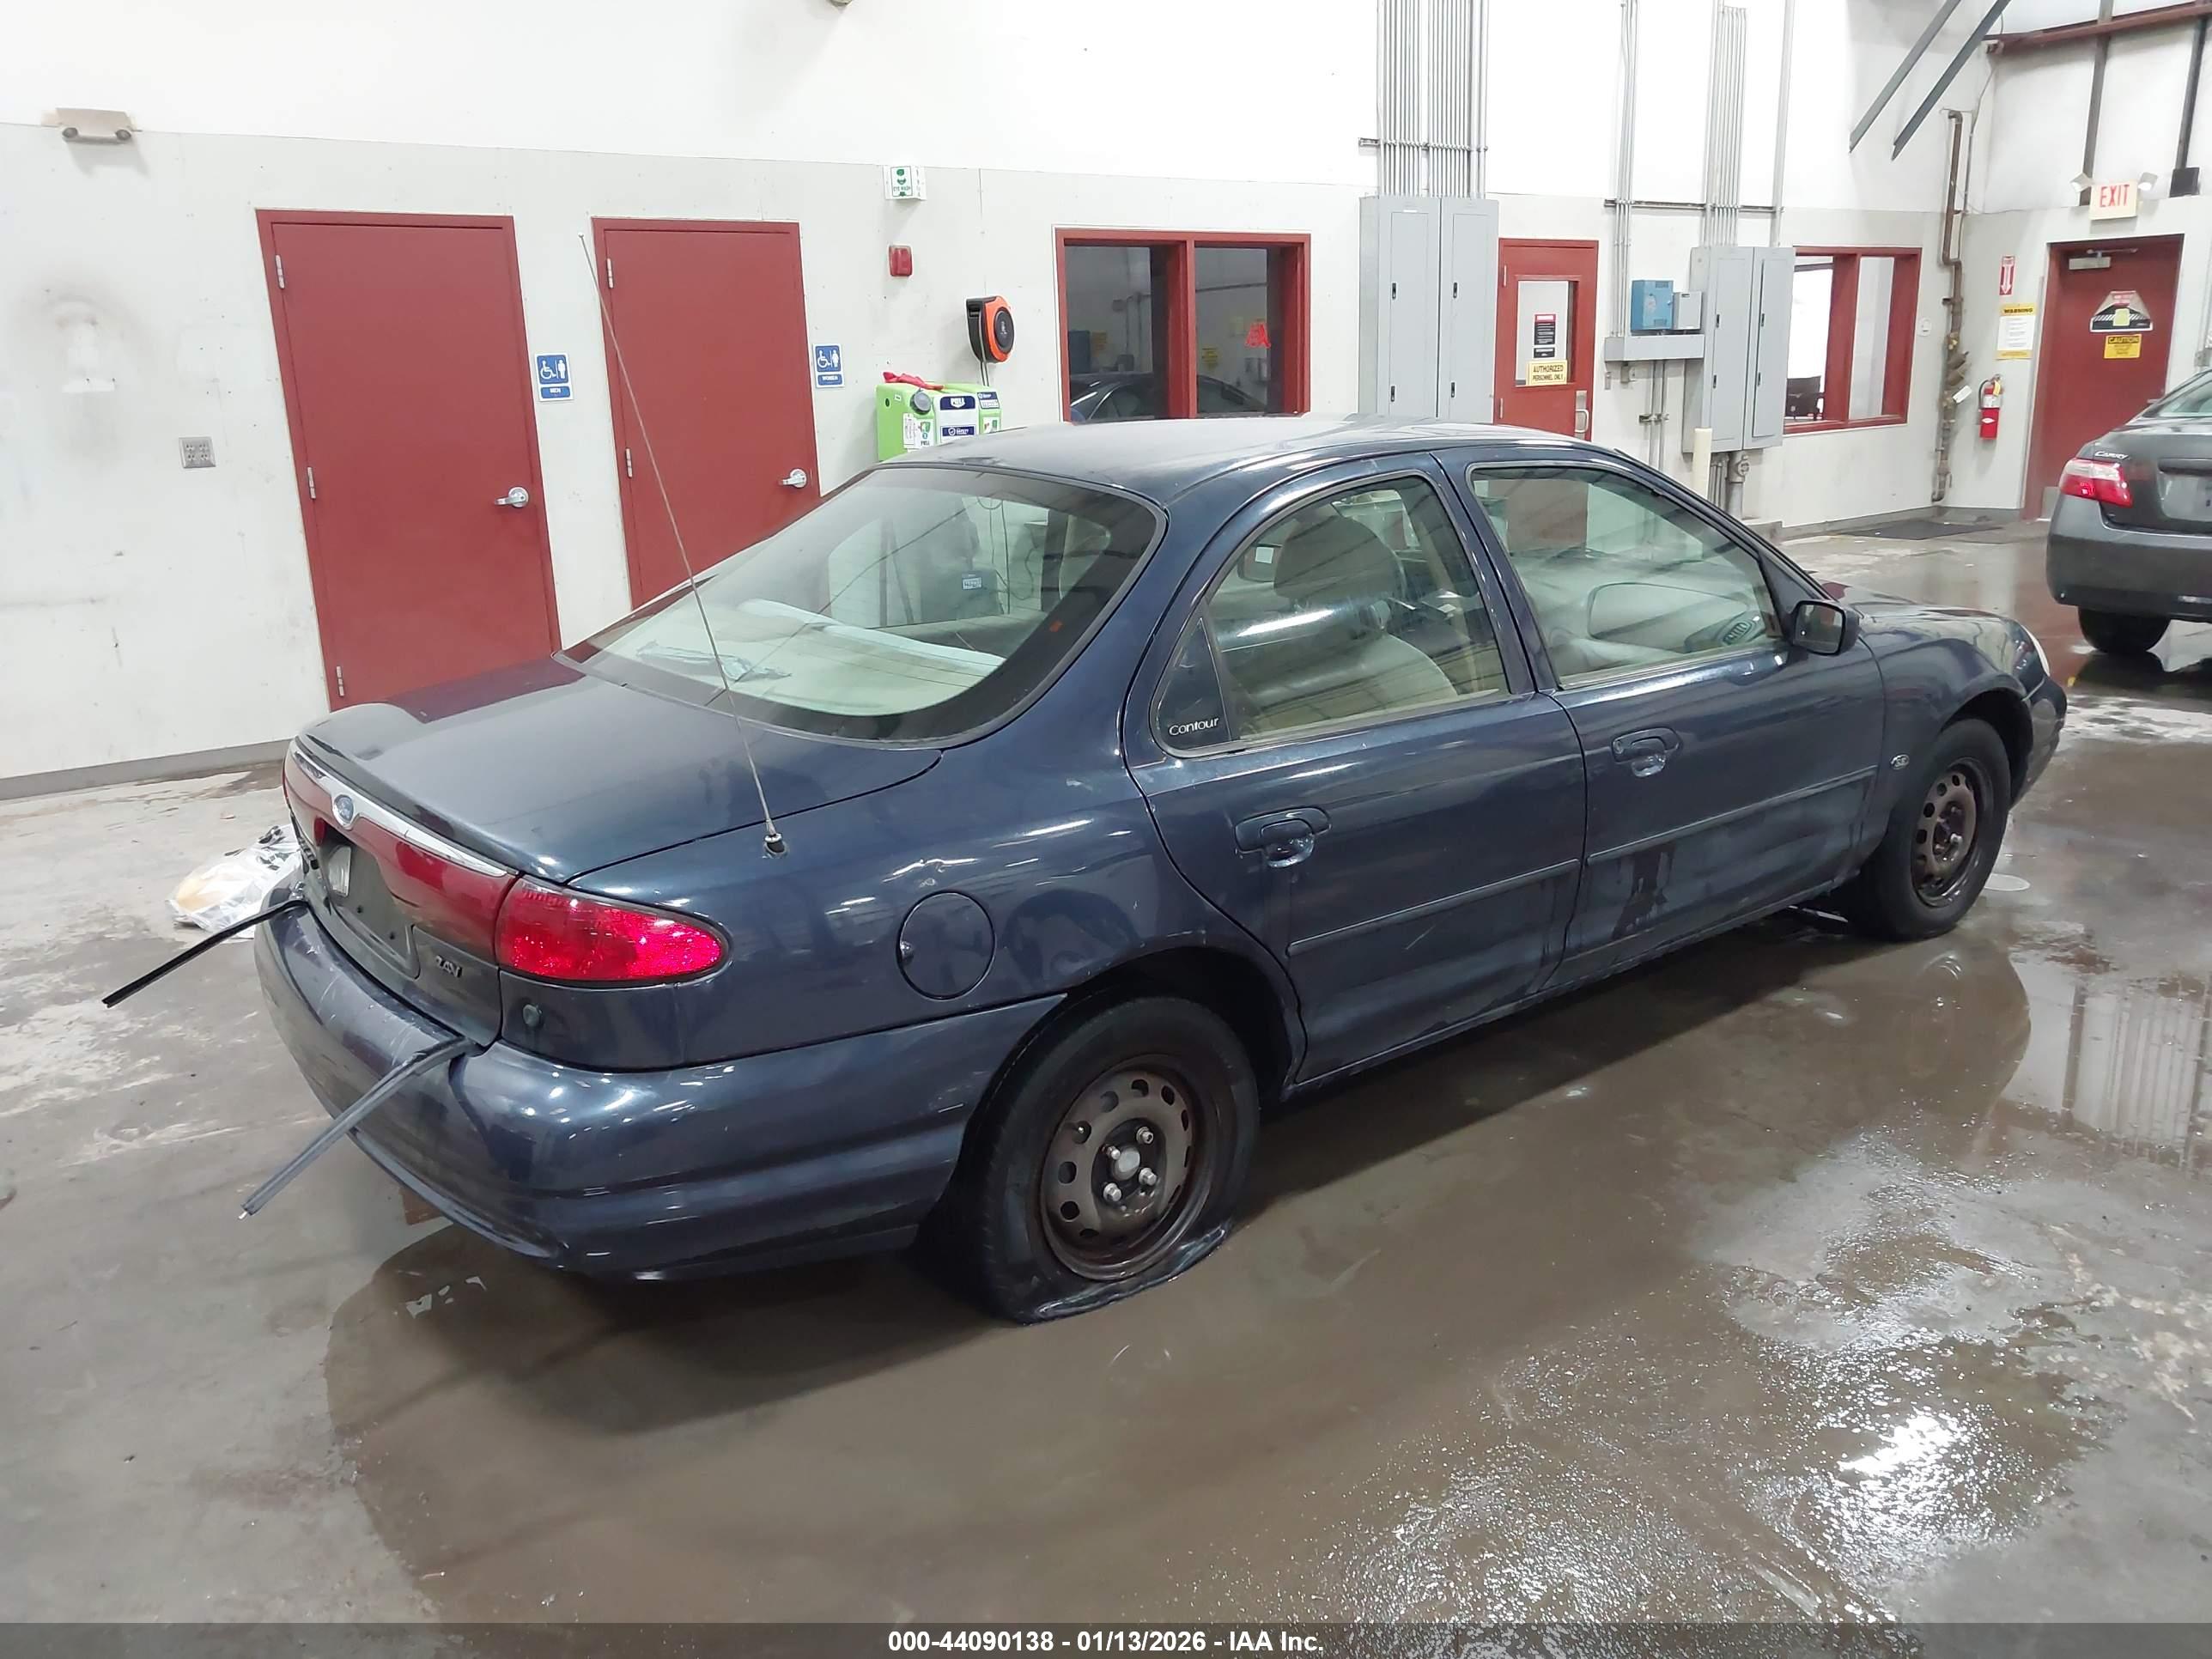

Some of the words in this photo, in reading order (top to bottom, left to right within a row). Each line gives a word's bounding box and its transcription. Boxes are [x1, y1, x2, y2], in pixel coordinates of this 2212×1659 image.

[2100, 184, 2130, 207] EXIT
[1533, 364, 1564, 373] AUTHORIZED
[1169, 717, 1219, 736] Contour
